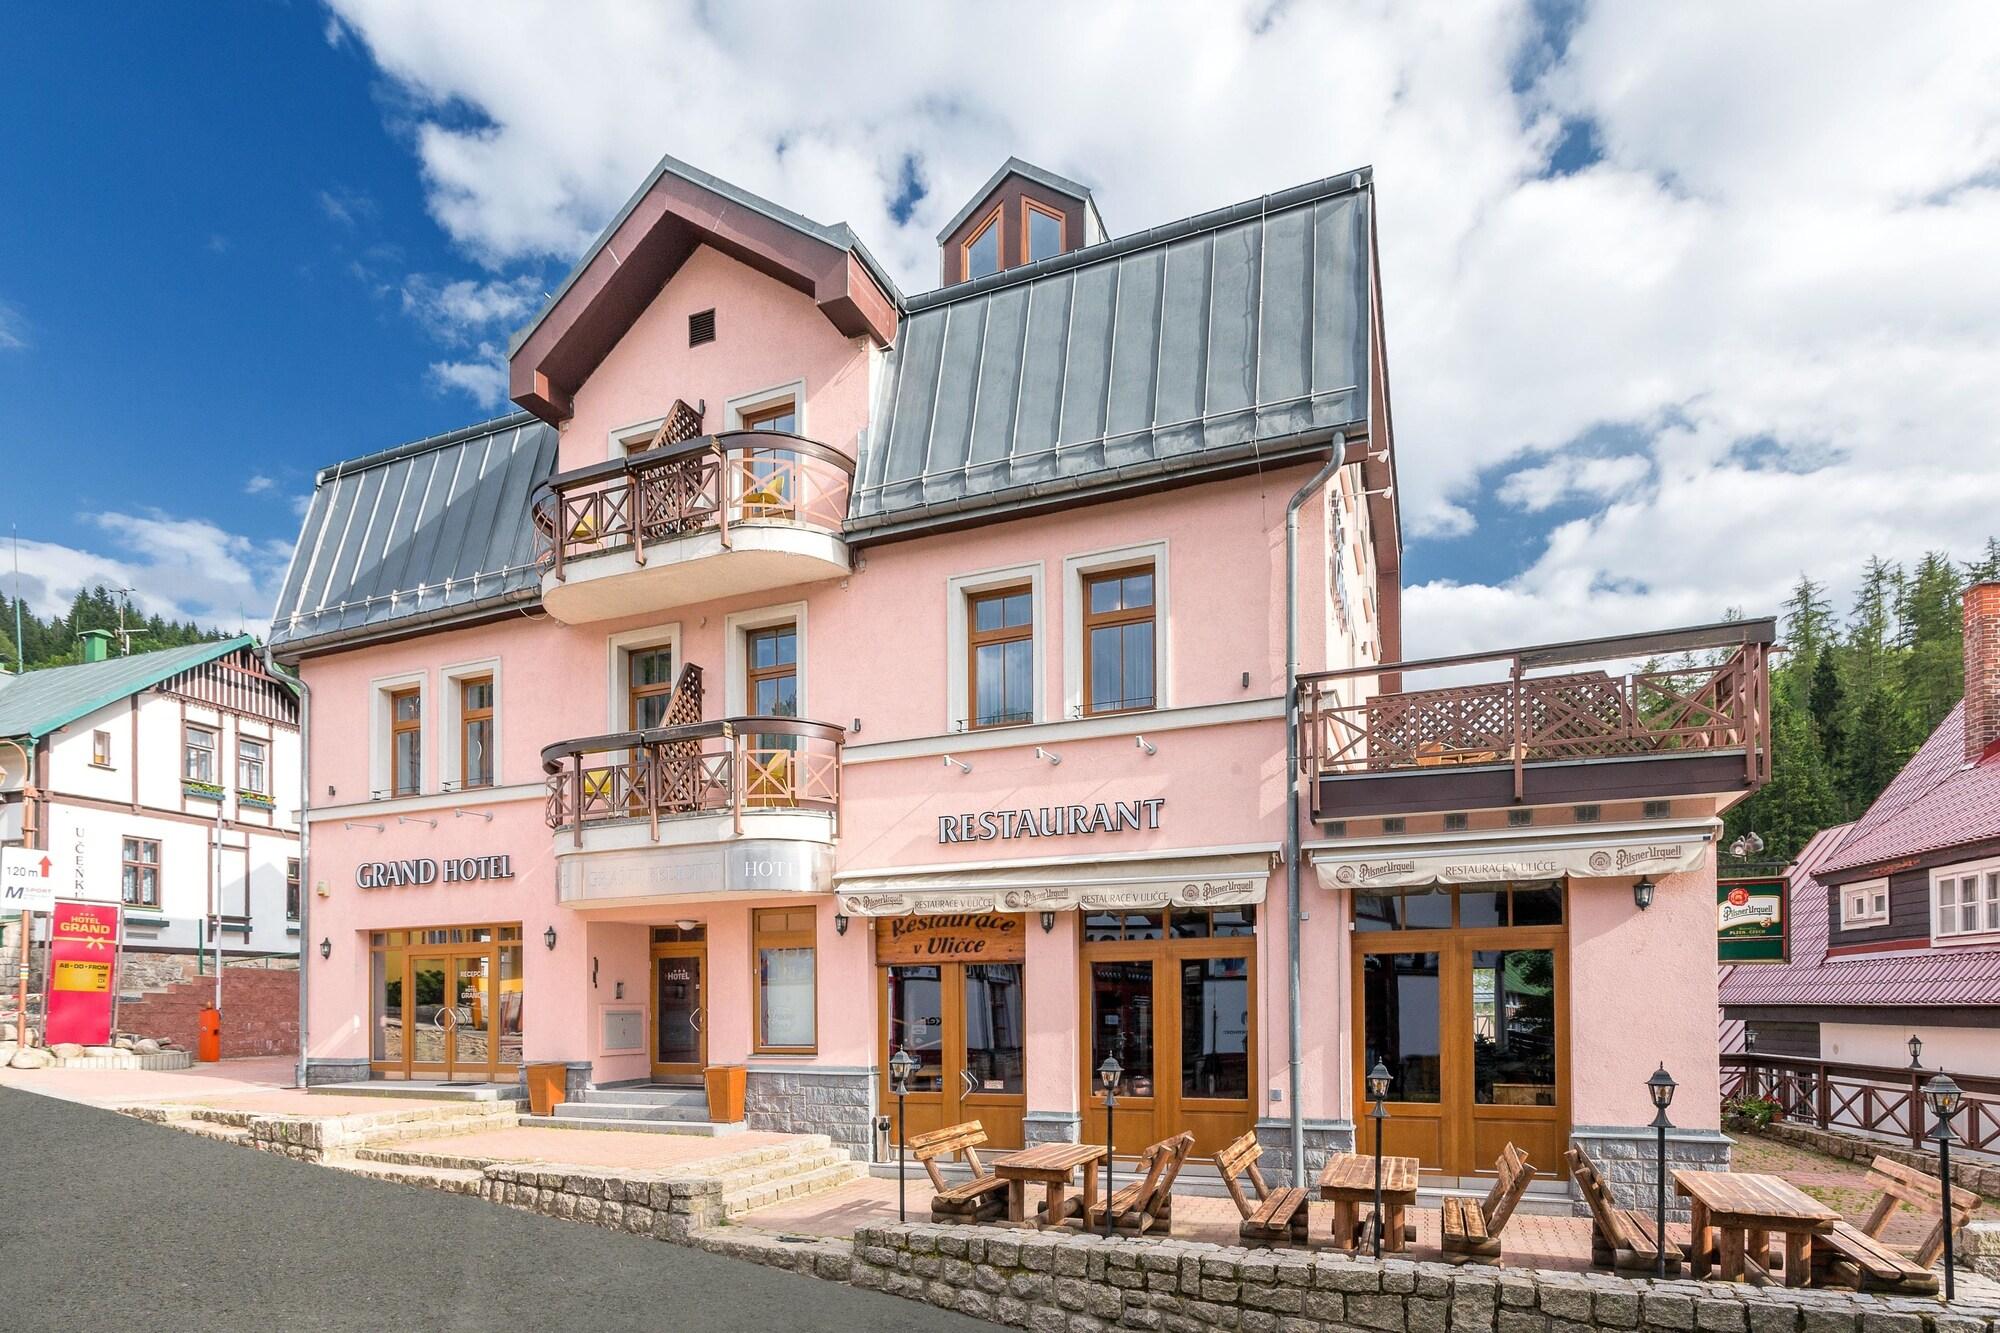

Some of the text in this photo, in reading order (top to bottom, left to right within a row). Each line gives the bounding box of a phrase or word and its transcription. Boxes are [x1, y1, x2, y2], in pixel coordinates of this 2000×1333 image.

[938, 798, 1165, 844] RESTAURANT
[1616, 846, 1682, 870] Pilsner Urquell
[7, 866, 38, 877] 120 m
[355, 854, 515, 889] GRAND HOTEL
[744, 860, 794, 878] HOT
[1359, 861, 1415, 882] Pilsner Urquell
[1445, 861, 1556, 876] RESTAURACE V ULIČCE
[5, 886, 24, 899] M
[1132, 893, 1139, 902] V
[1141, 891, 1169, 902] ULIČCE
[1202, 880, 1254, 900] Pilsner Urquell
[70, 915, 101, 925] HOTEL
[1723, 904, 1773, 921] Pilsner Urquell
[60, 922, 110, 934] GRAND
[891, 912, 1016, 938] Restaurace
[913, 937, 986, 955] v Uličce
[668, 972, 690, 981] HOTEL
